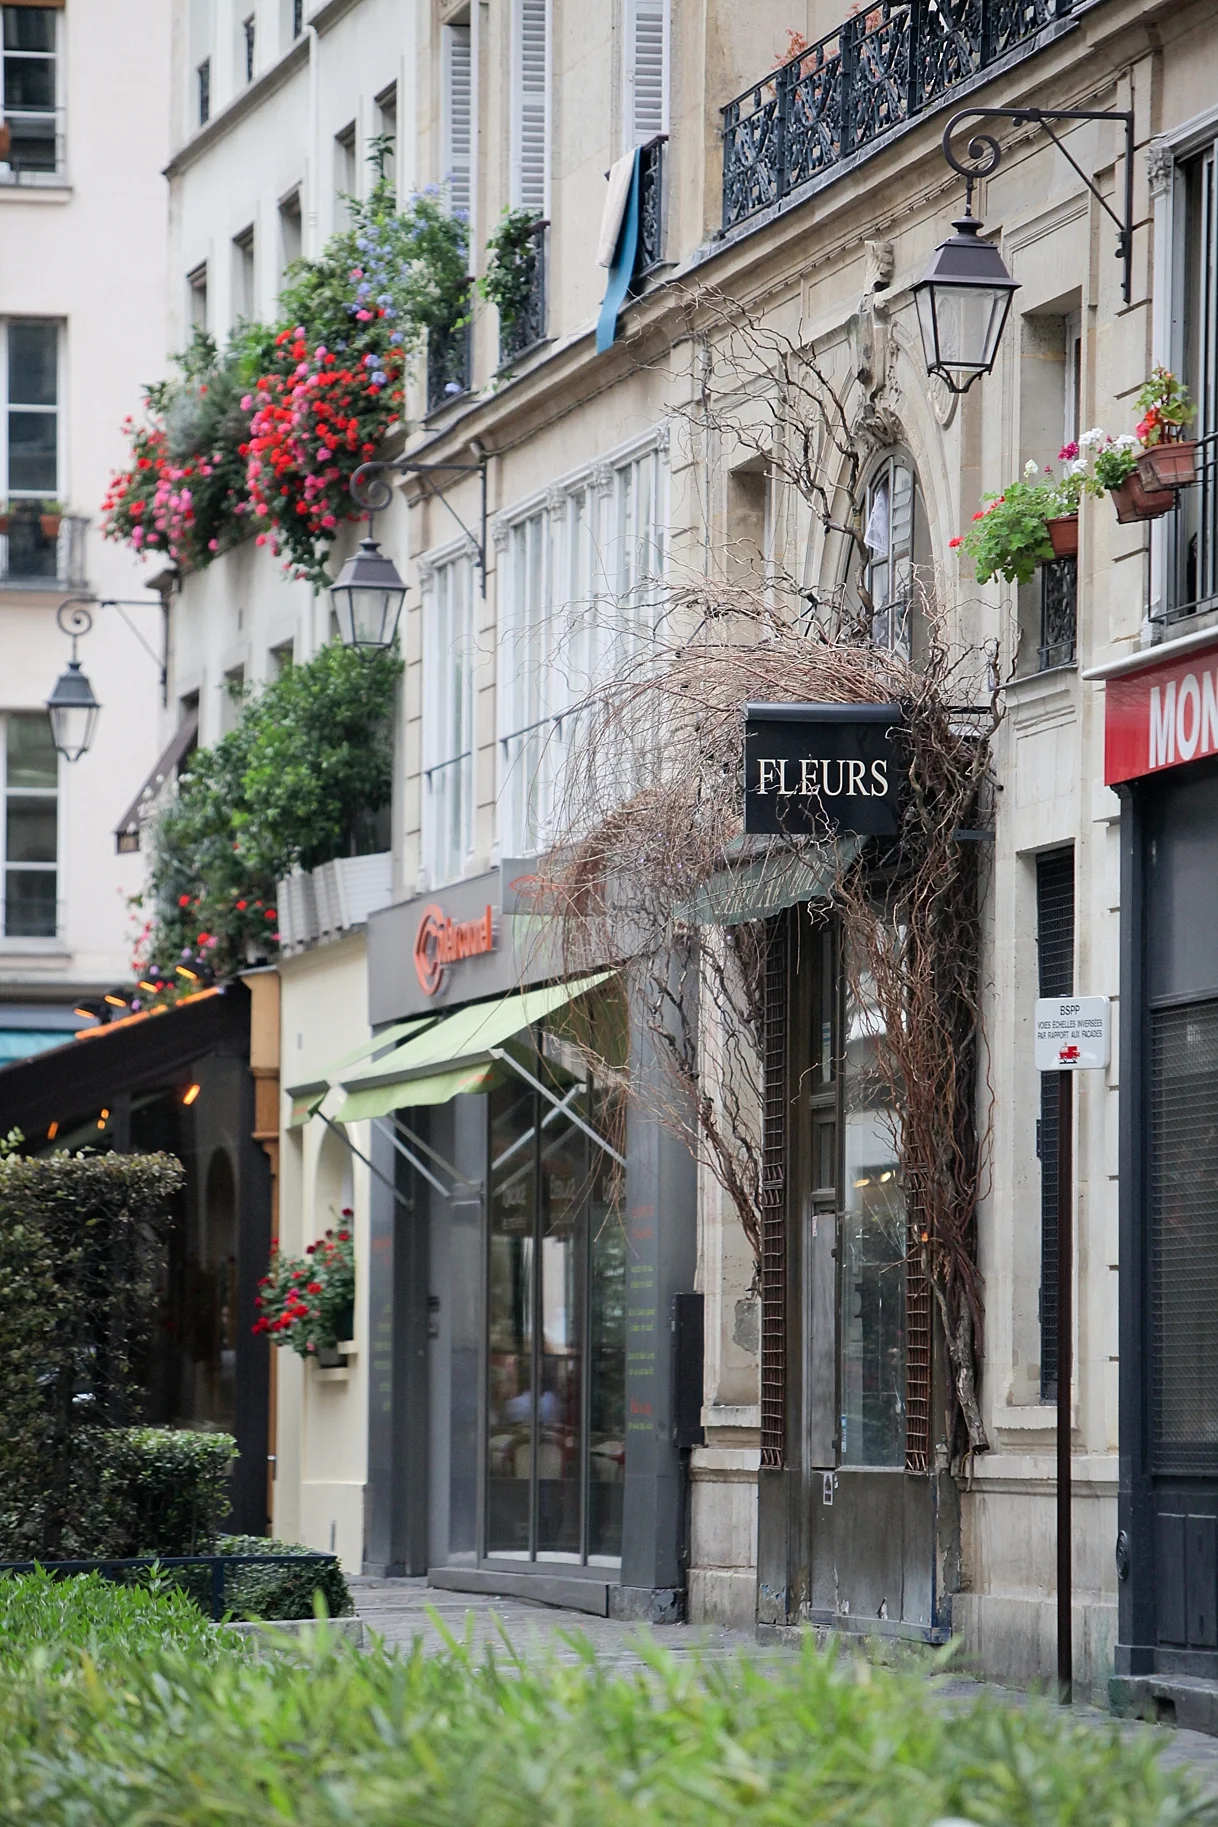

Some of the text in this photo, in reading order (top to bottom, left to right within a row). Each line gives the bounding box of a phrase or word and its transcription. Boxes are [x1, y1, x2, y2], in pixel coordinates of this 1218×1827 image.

[756, 758, 889, 797] FLEURS
[1060, 1004, 1081, 1016] BSPP
[1037, 1018, 1103, 1030] VOIES ÉCHELLES INVERSÉES
[1037, 1029, 1102, 1039] PAR RAPPORT AUX FAÇADES
